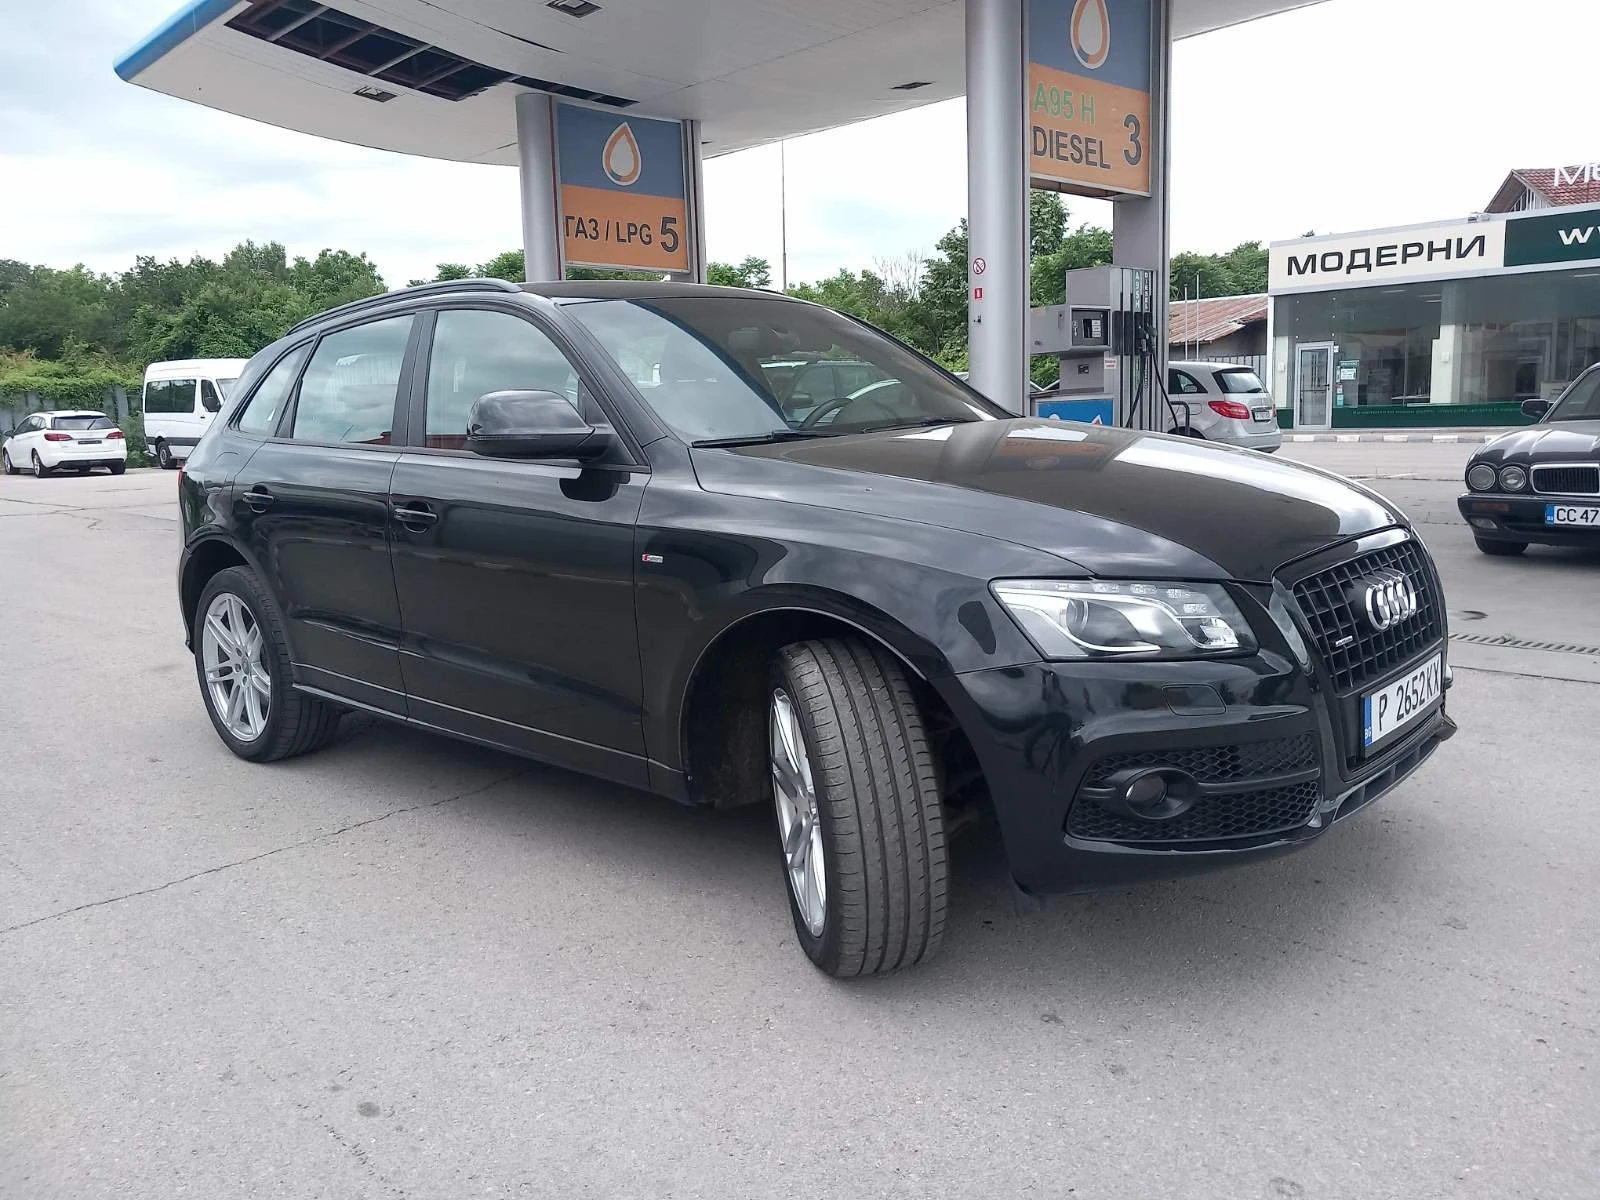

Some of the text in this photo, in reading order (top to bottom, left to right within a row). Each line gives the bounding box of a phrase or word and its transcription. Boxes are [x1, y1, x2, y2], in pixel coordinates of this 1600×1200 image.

[1033, 82, 1096, 125] A95 H
[1032, 125, 1111, 170] DIESEL
[1123, 113, 1142, 166] 3
[564, 215, 600, 241] ГАЗ
[616, 221, 653, 246] LPG
[660, 216, 679, 253] 5
[1286, 234, 1486, 277] МОДЕРНИ
[1556, 508, 1577, 523] CC
[1378, 693, 1388, 732] P
